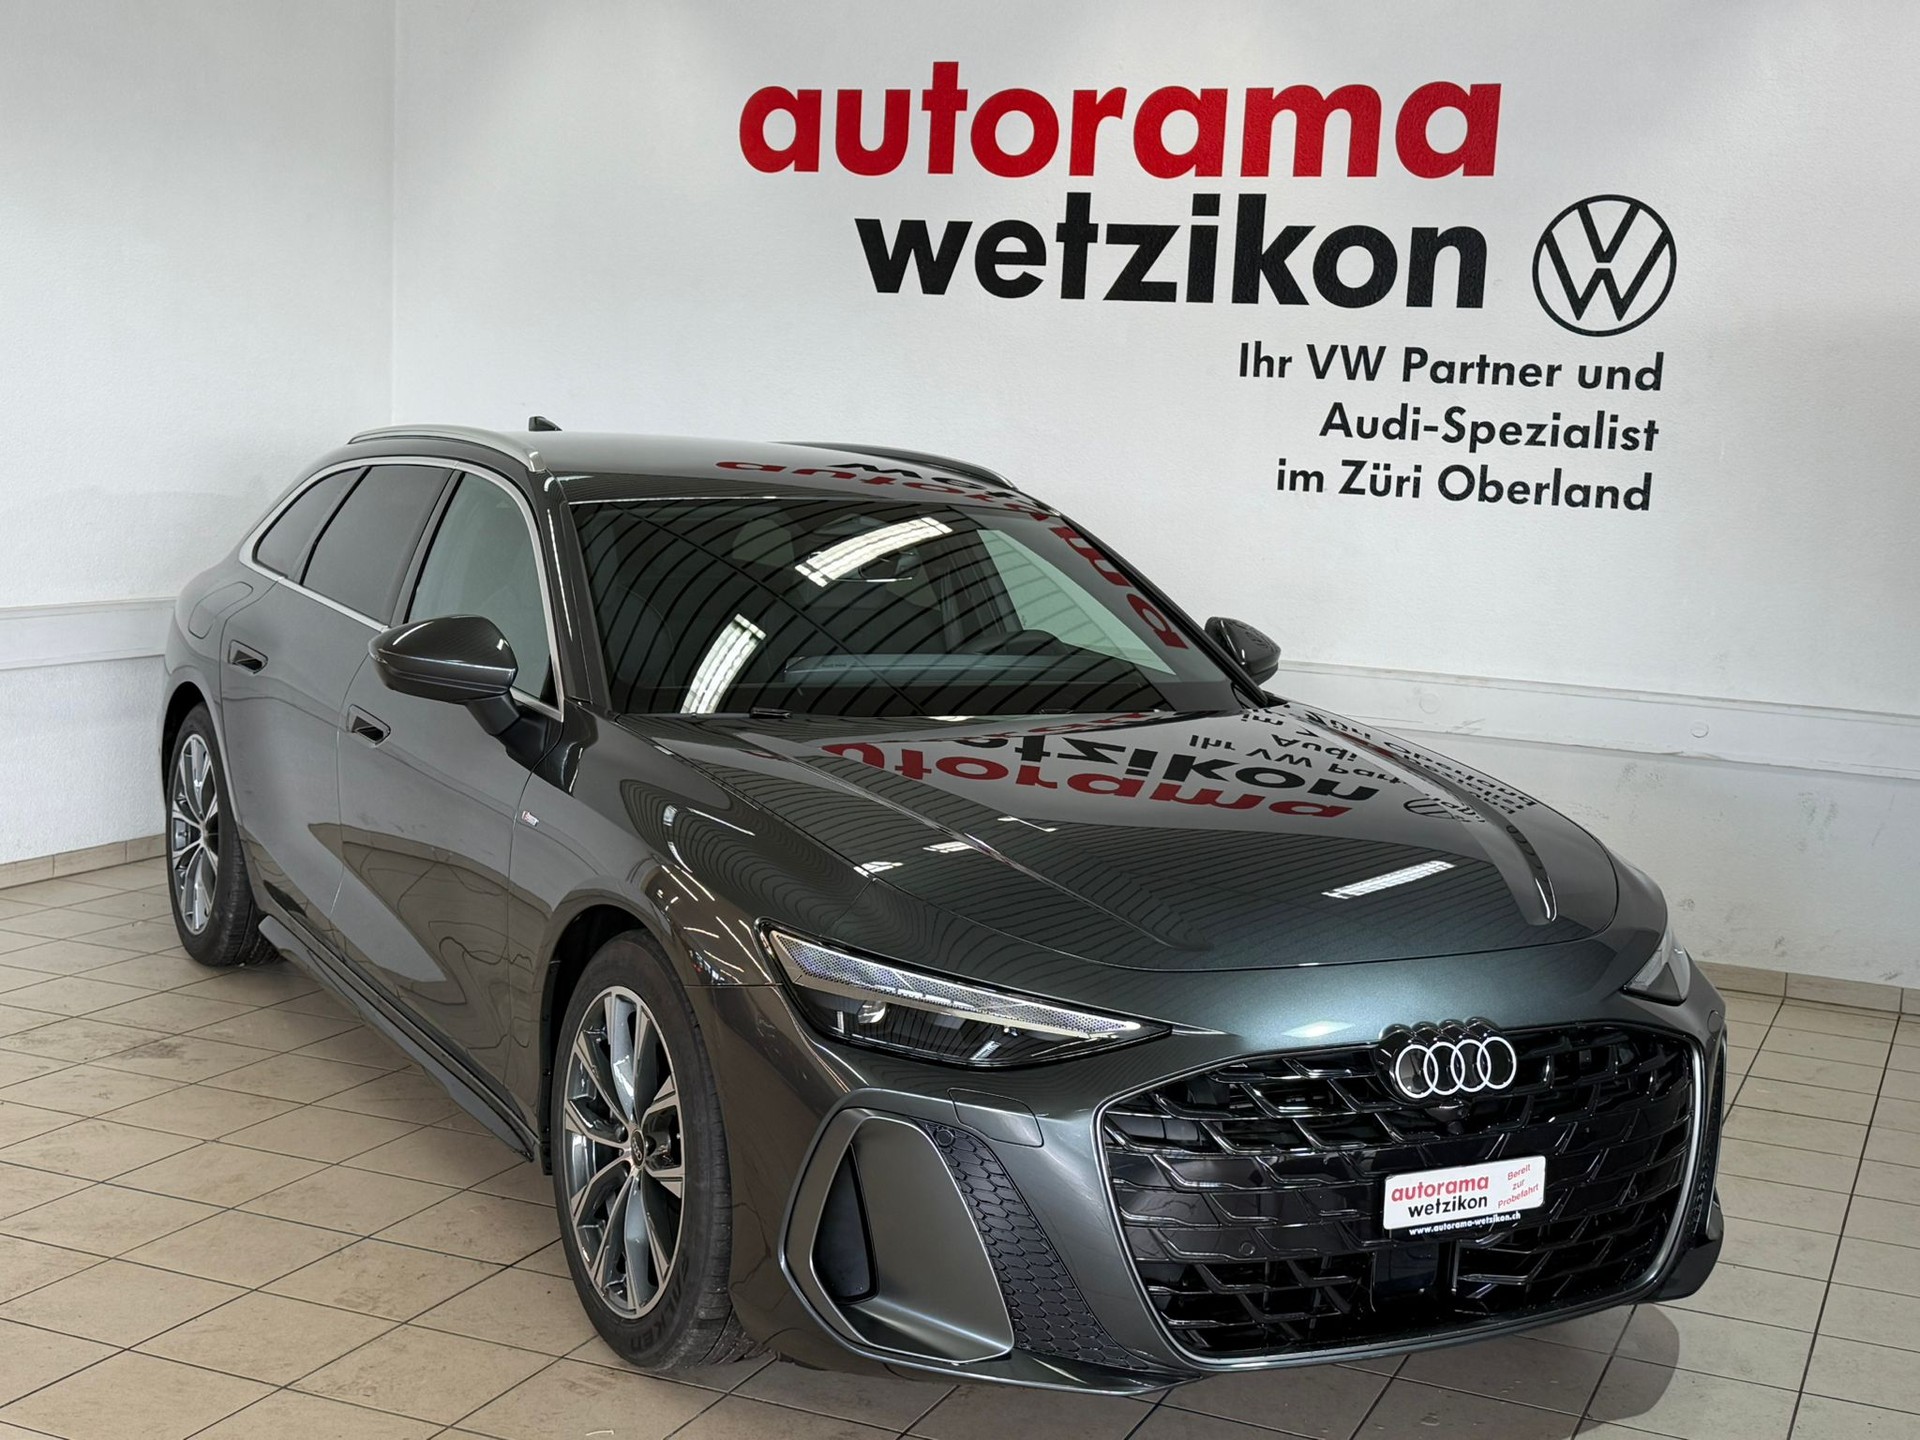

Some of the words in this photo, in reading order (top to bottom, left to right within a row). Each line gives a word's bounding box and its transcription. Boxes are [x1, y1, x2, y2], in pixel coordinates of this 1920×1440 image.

[739, 61, 1503, 180] autorama
[855, 192, 1487, 309] wetzikon
[1239, 340, 1293, 378] Ihr
[1306, 344, 1387, 381] VW
[1402, 346, 1562, 387] Partner
[1577, 351, 1665, 391] und
[1319, 402, 1660, 454] Audi-Spezialist
[1277, 458, 1324, 493] im
[1338, 459, 1422, 499] Züri
[1437, 464, 1653, 511] Oberland
[1507, 1163, 1531, 1181] Bereit
[1512, 1179, 1525, 1191] zur
[1391, 1176, 1490, 1202] autorama
[1497, 1183, 1539, 1209] Probefahrt
[1408, 1195, 1488, 1219] wetzikon
[1408, 1210, 1522, 1236] www.autorama-wetzikon.ch
